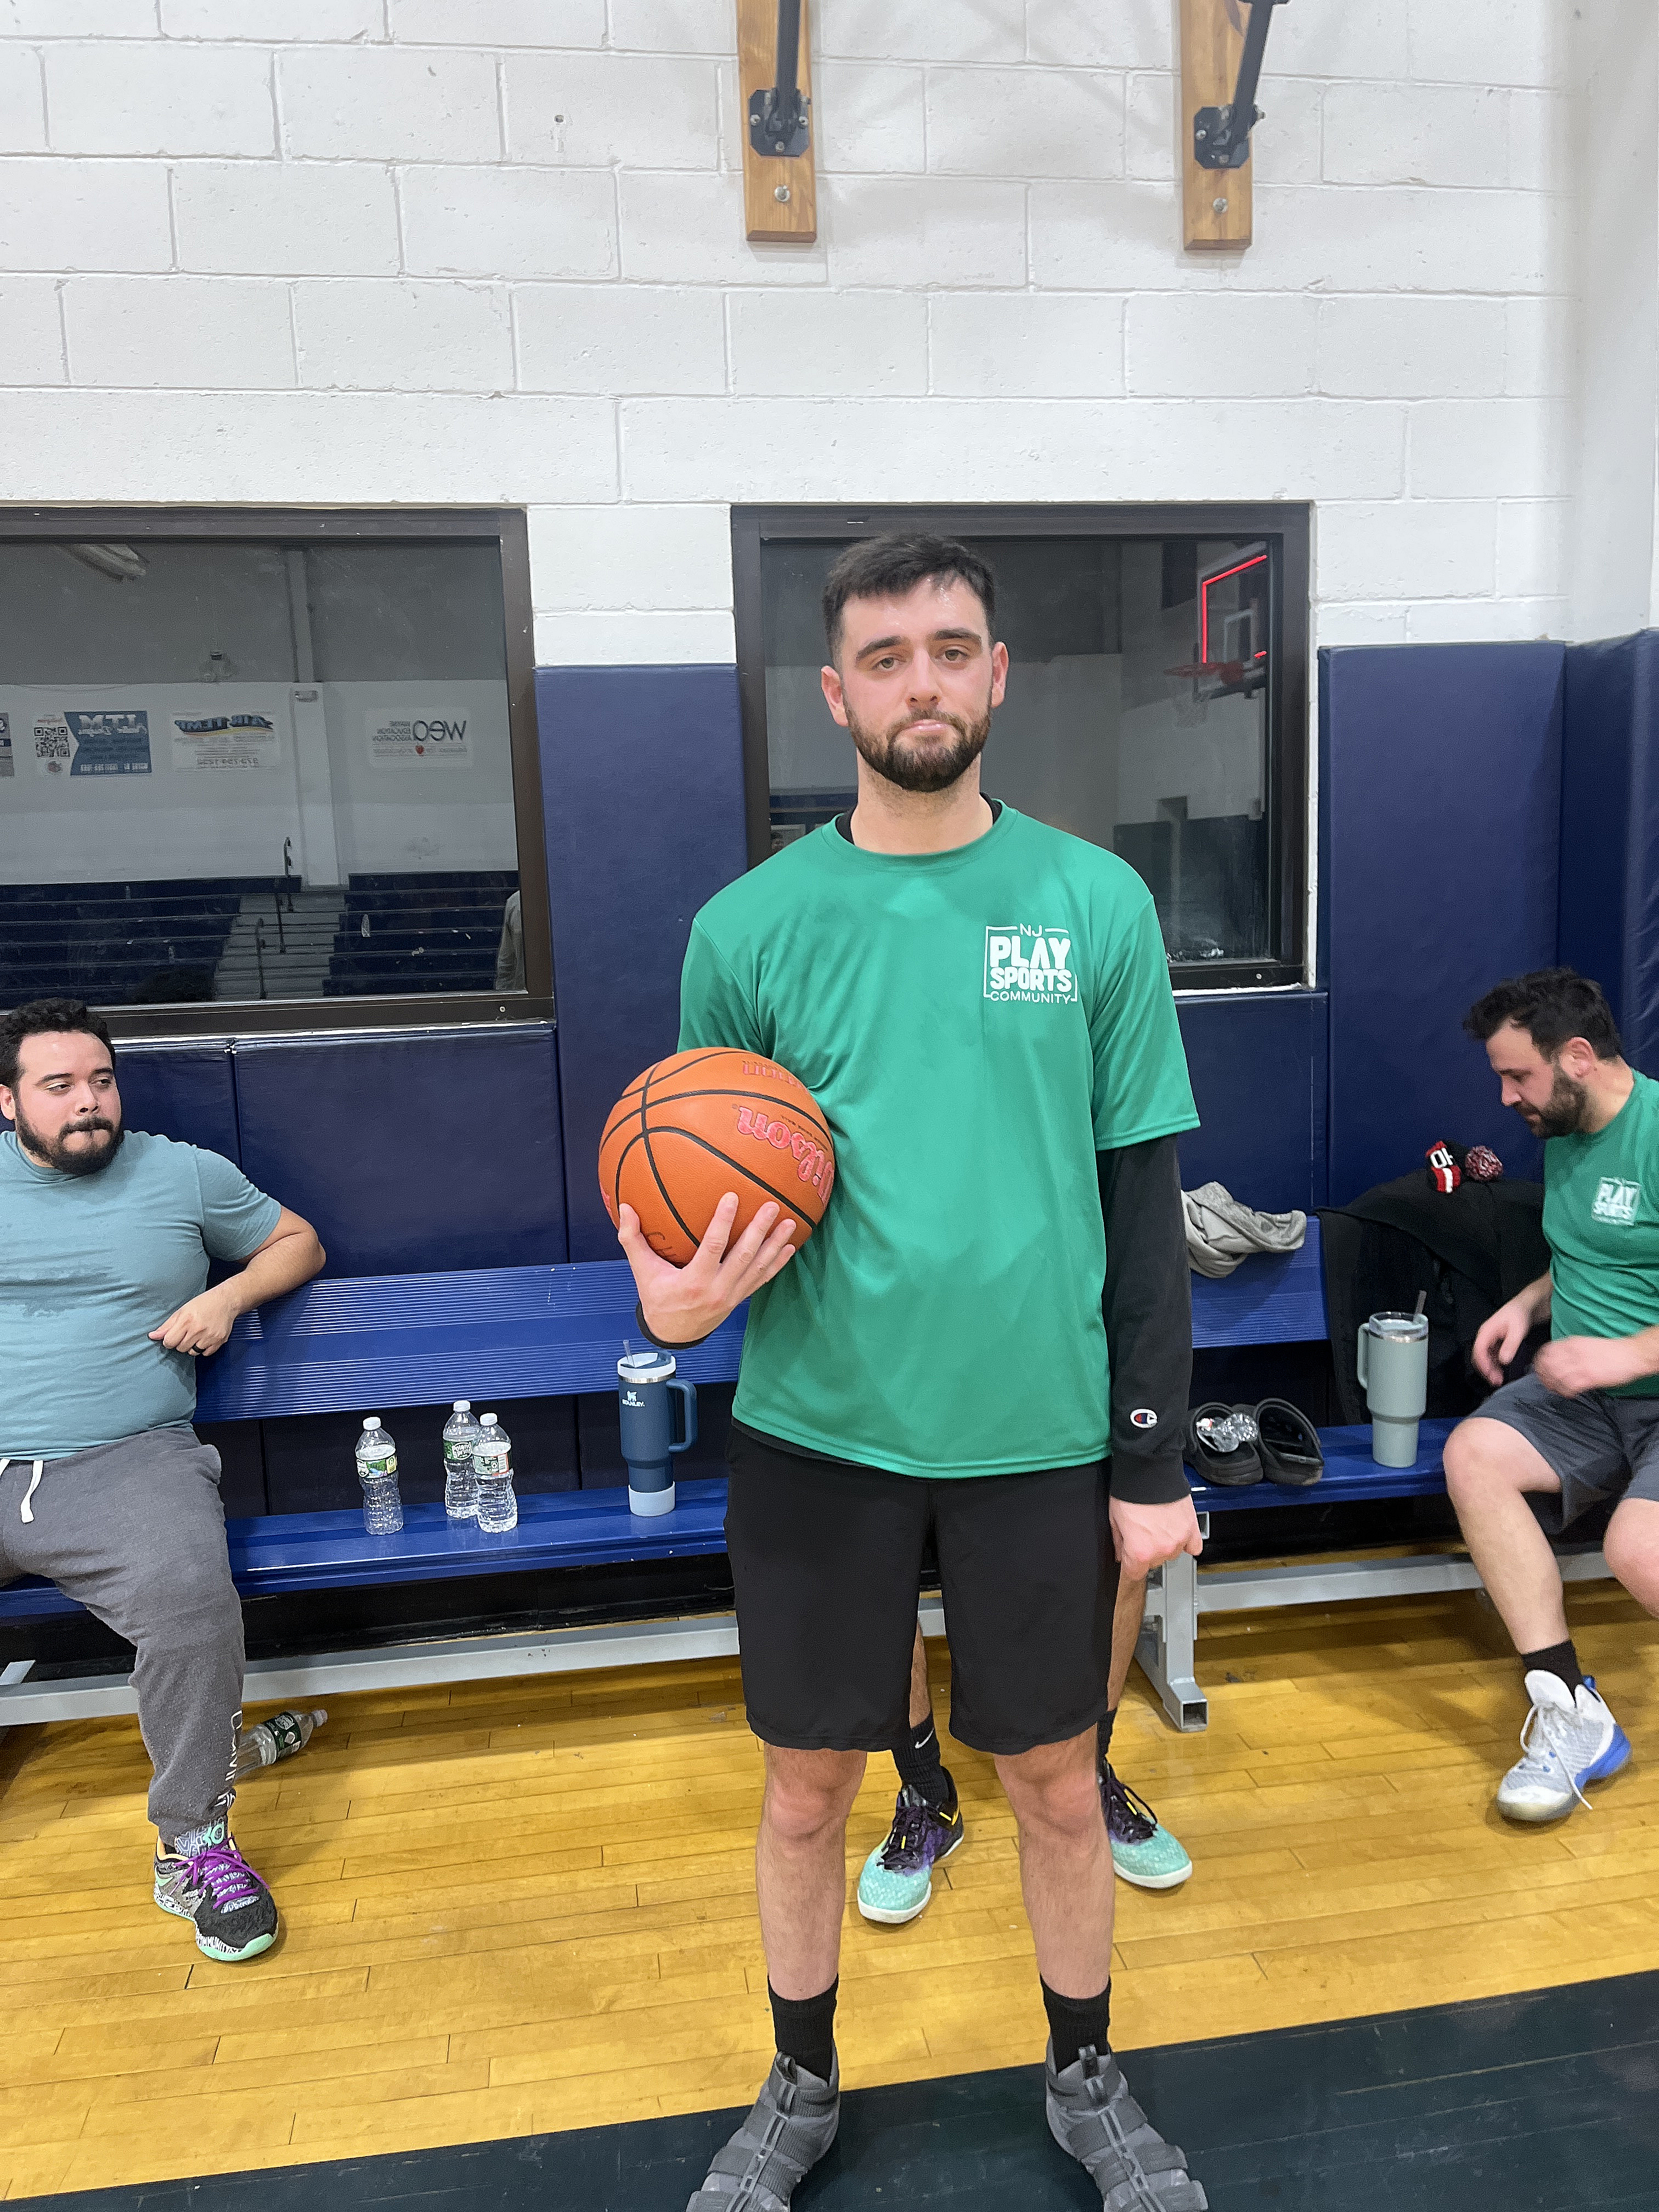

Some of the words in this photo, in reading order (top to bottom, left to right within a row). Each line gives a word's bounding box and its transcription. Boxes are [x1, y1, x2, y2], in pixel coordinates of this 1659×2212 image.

[1019, 923, 1043, 937] NJ
[989, 935, 1071, 970] PLAY
[989, 966, 1072, 993] SPORTS
[990, 990, 1071, 1005] COMMUNITY
